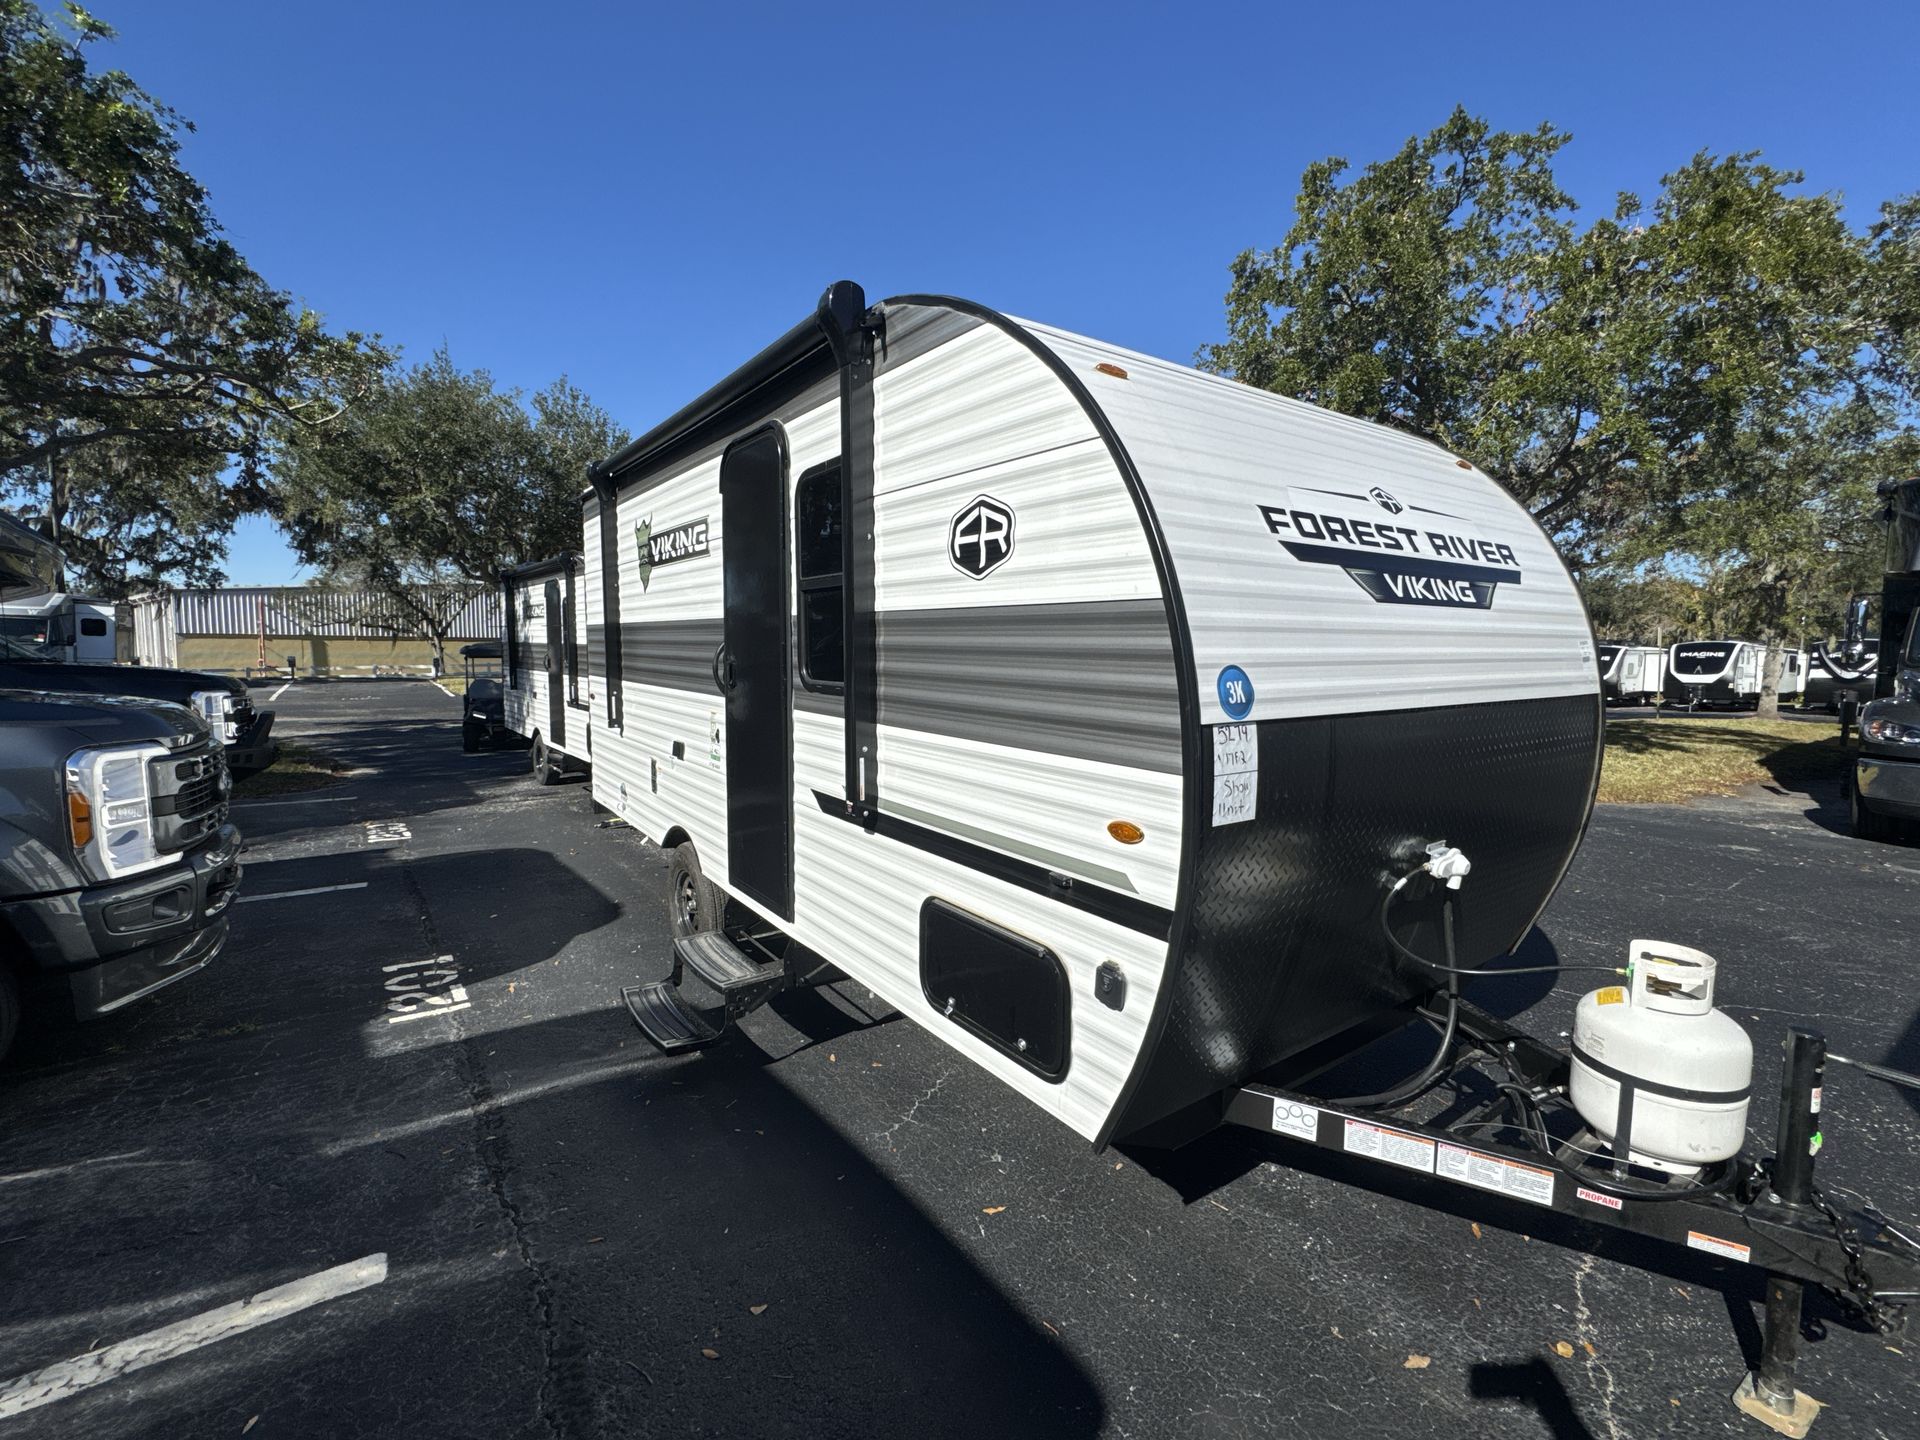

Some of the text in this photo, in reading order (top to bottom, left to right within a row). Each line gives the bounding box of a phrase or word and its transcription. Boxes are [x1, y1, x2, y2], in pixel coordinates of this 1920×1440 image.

[650, 523, 706, 562] VIKING
[1256, 504, 1520, 567] FOREST RIVER
[1383, 573, 1477, 603] VIKING
[1226, 680, 1246, 704] 3K
[1579, 1189, 1621, 1208] PROPANE
